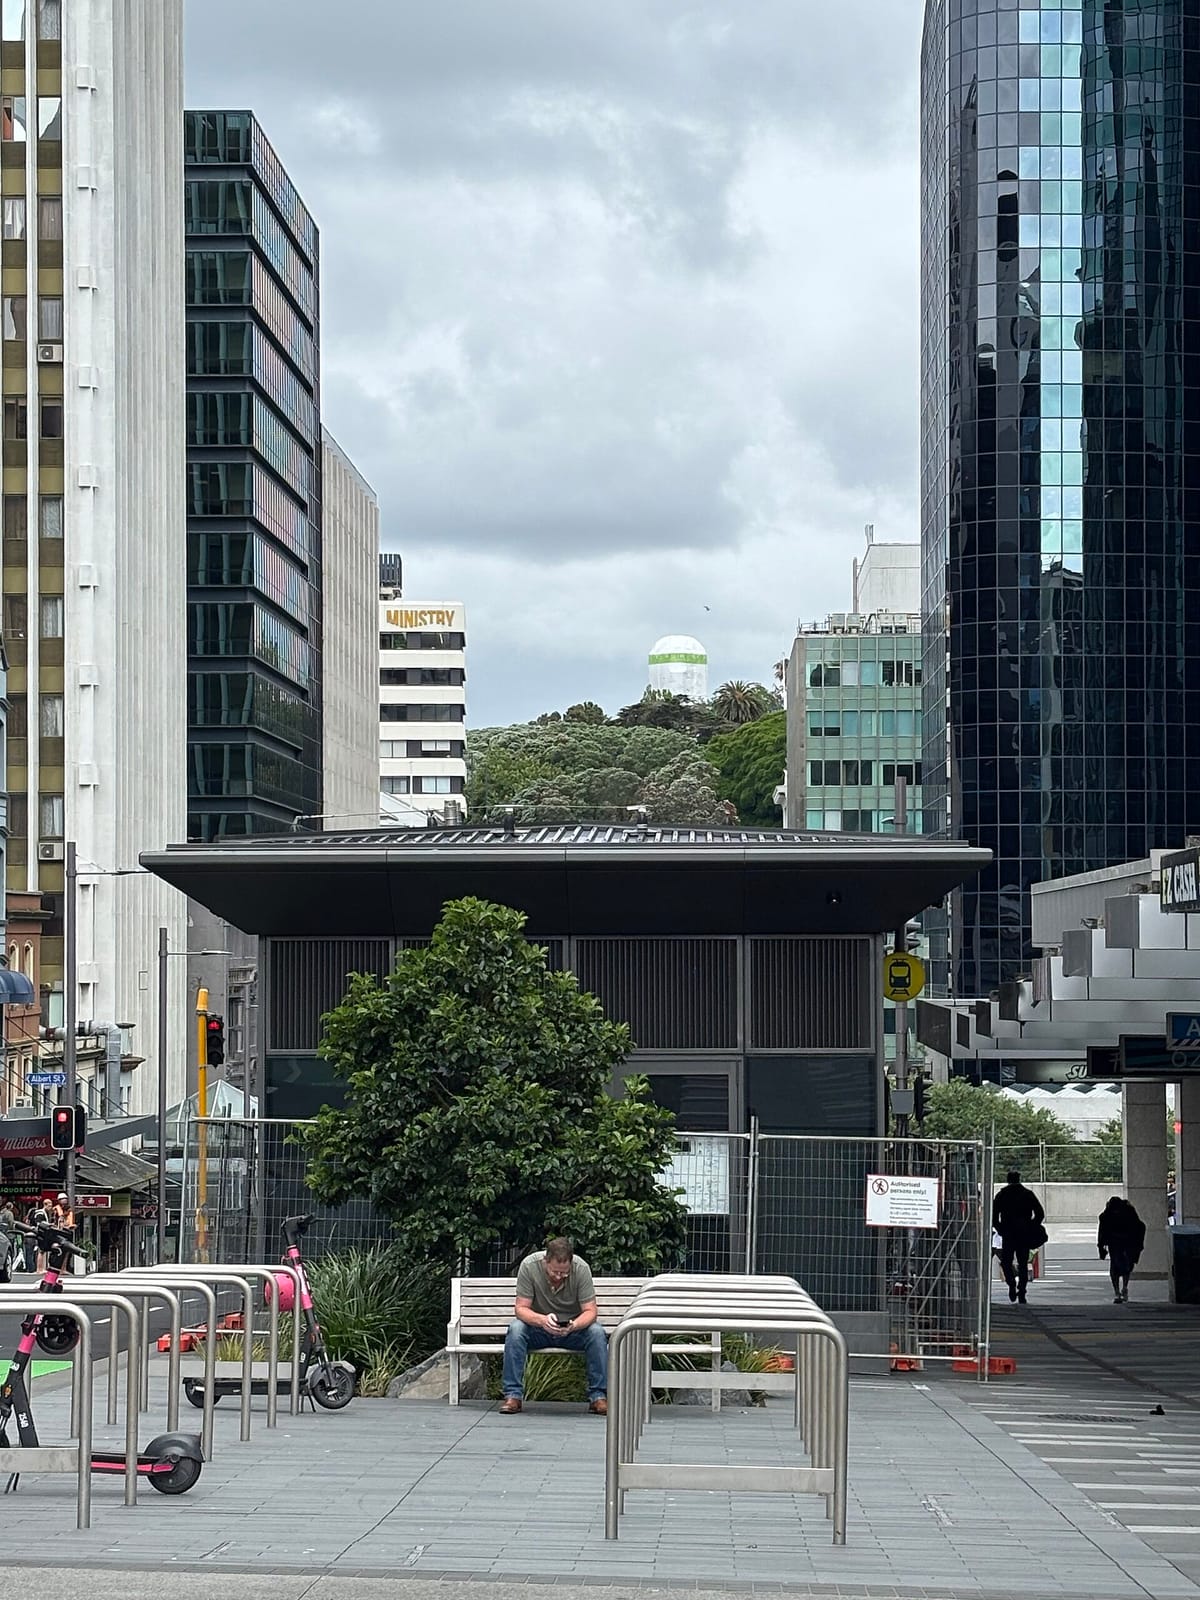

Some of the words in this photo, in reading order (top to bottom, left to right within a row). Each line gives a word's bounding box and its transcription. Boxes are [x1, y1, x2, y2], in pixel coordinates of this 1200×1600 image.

[386, 610, 455, 628] MINISTRY
[1174, 862, 1197, 903] CASH
[4, 1137, 47, 1150] Millers
